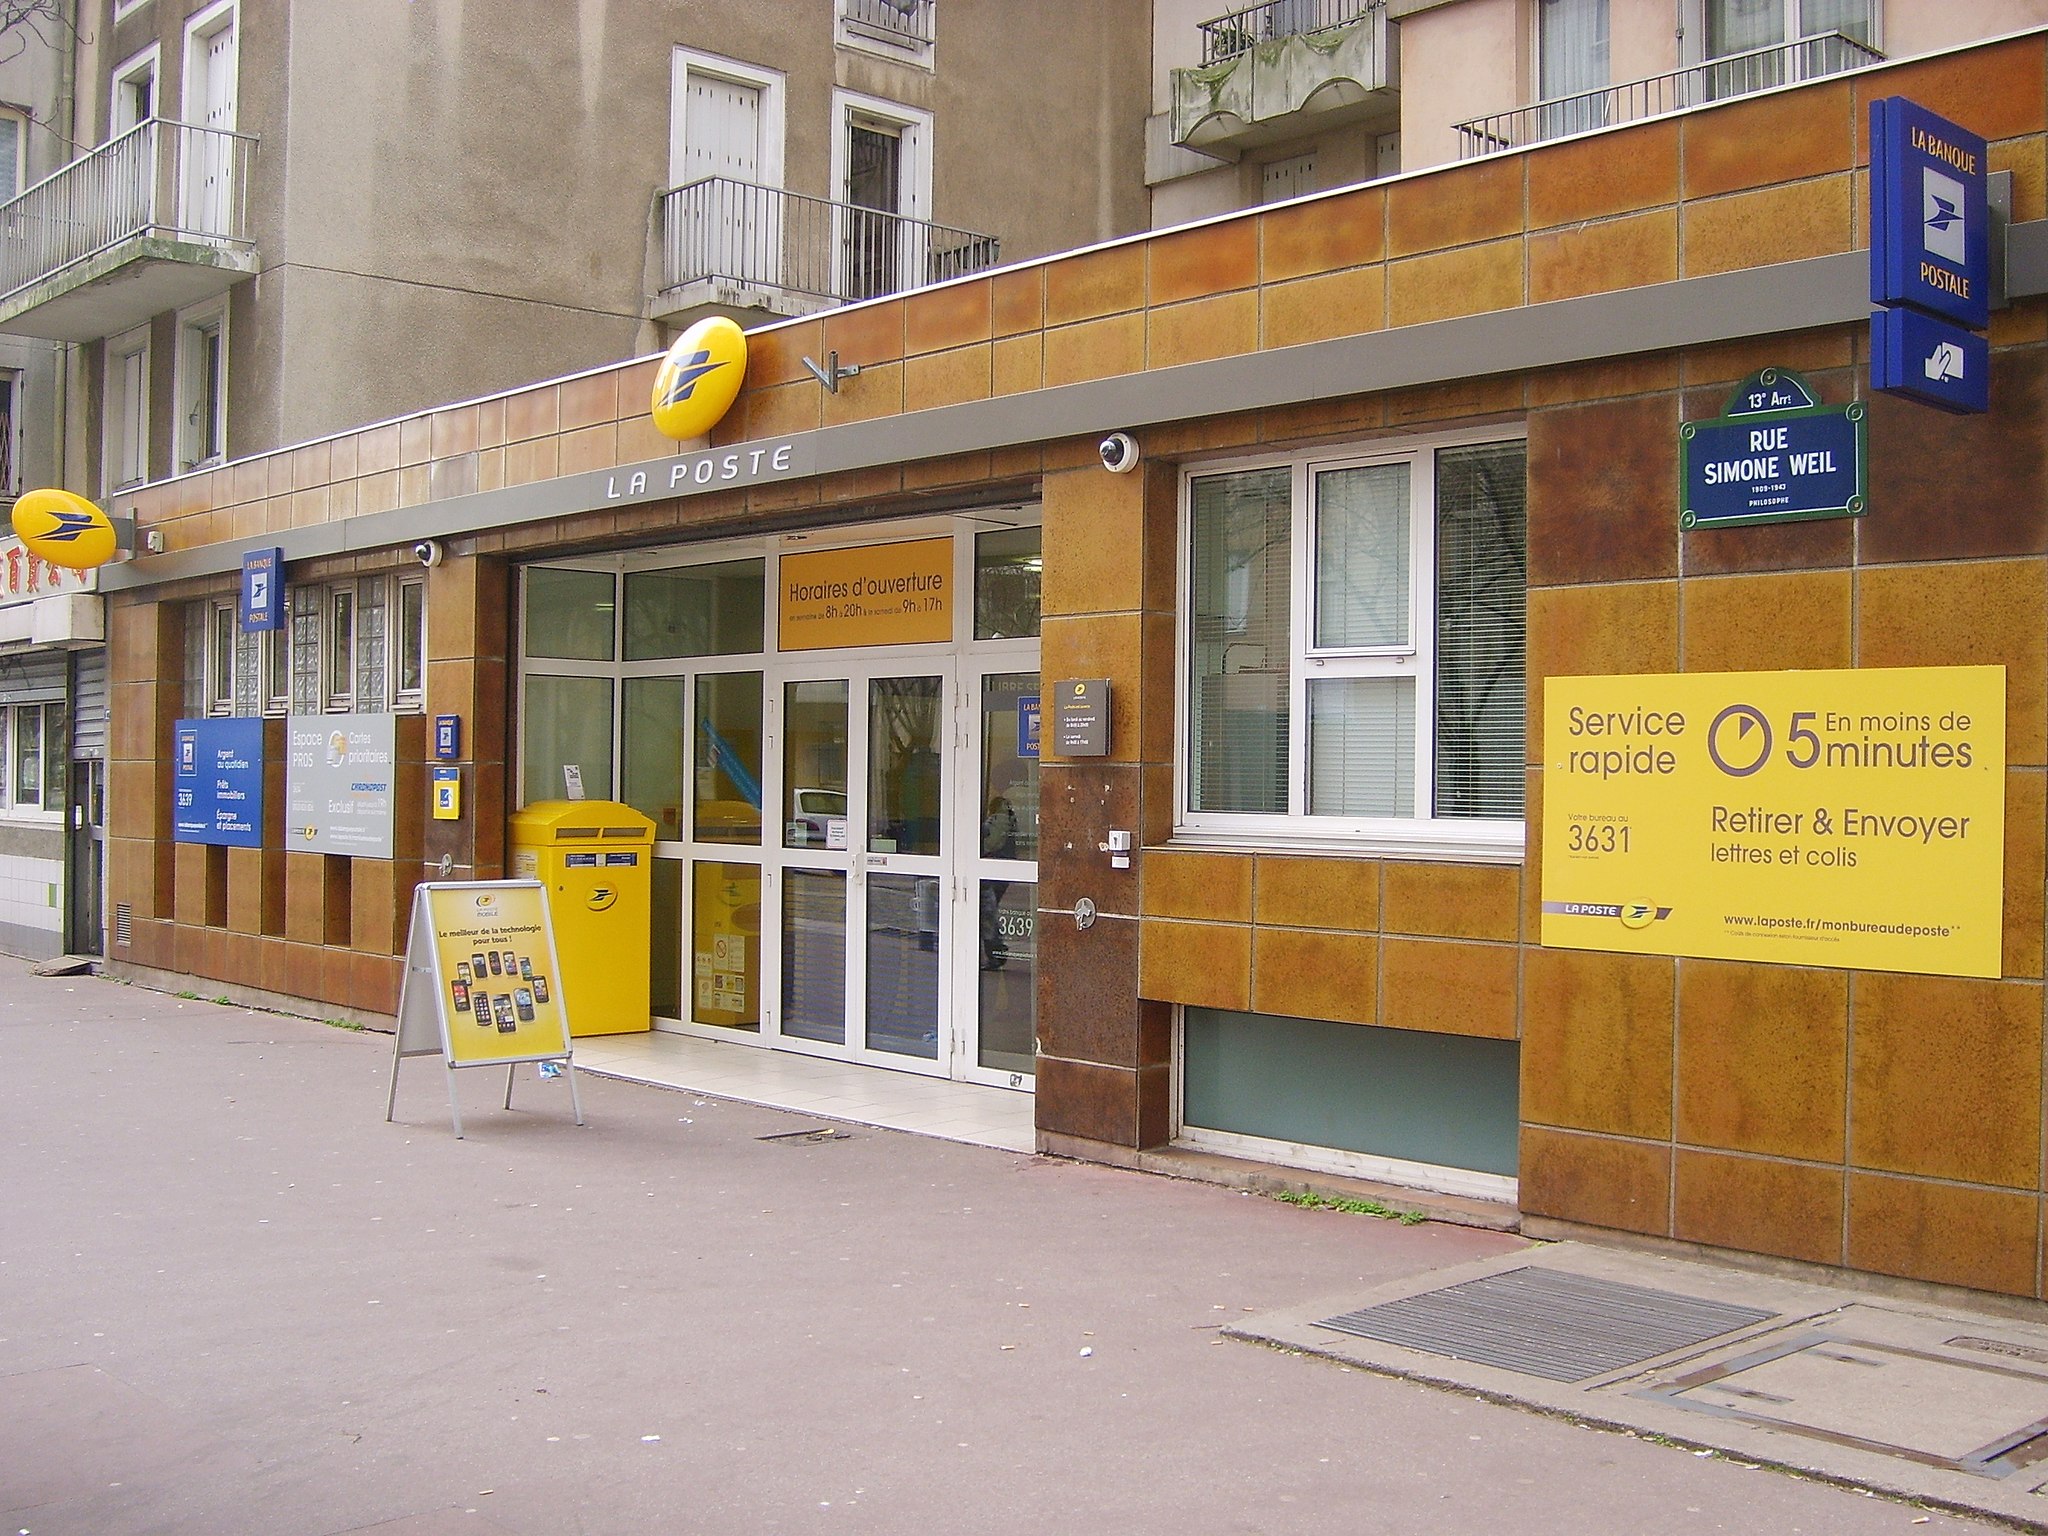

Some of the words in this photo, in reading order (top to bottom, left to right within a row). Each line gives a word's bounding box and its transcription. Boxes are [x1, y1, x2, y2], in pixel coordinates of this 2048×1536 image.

[1911, 126, 1927, 152] LA
[1928, 134, 1976, 176] BANQUE
[1920, 262, 1970, 299] POSTALE
[1750, 427, 1789, 452] RUE
[607, 470, 648, 499] LA
[669, 444, 793, 489] POSTE
[1704, 456, 1779, 485] SIMONE
[1789, 451, 1837, 476] WEIL
[1748, 496, 1789, 507] PHILOSOPHE
[790, 580, 848, 602] Horaires
[852, 571, 943, 597] d'ouverture
[825, 605, 838, 619] 8h
[843, 603, 862, 618] 20h
[902, 599, 916, 613] 9h
[923, 597, 943, 611] 17h
[1567, 705, 1687, 737] Service
[293, 730, 322, 748] Espace
[348, 731, 371, 744] Cartes
[1785, 711, 1822, 769] 5
[1826, 712, 1851, 732] En
[1859, 711, 1931, 732] moins
[1941, 711, 1972, 731] de
[217, 749, 234, 760] Argent
[293, 752, 313, 767] PROS
[348, 748, 388, 765] prioritaires
[1826, 733, 1974, 769] minutes
[225, 759, 249, 770] quotidien
[1569, 744, 1677, 780] rapide
[216, 790, 246, 800] immobiliers
[351, 782, 387, 792] CHRONOPOST
[178, 793, 193, 806] 3639
[328, 799, 355, 814] Exclusif
[1568, 813, 1587, 822] Votre
[1589, 813, 1617, 822] bureau
[1711, 806, 1804, 835] Retirer
[1812, 807, 1834, 836] &
[1844, 808, 1971, 844] Envoyer
[222, 822, 252, 832] placements
[1568, 824, 1630, 853] 3631
[1711, 842, 1773, 864] lettres
[1779, 846, 1800, 865] et
[1806, 847, 1858, 867] colis
[1565, 904, 1580, 914] LA
[1581, 905, 1617, 916] POSTE
[450, 929, 479, 937] meilleur
[500, 924, 542, 936] technologie
[998, 916, 1033, 937] 3639
[473, 937, 490, 946] pour
[492, 936, 508, 944] tous
